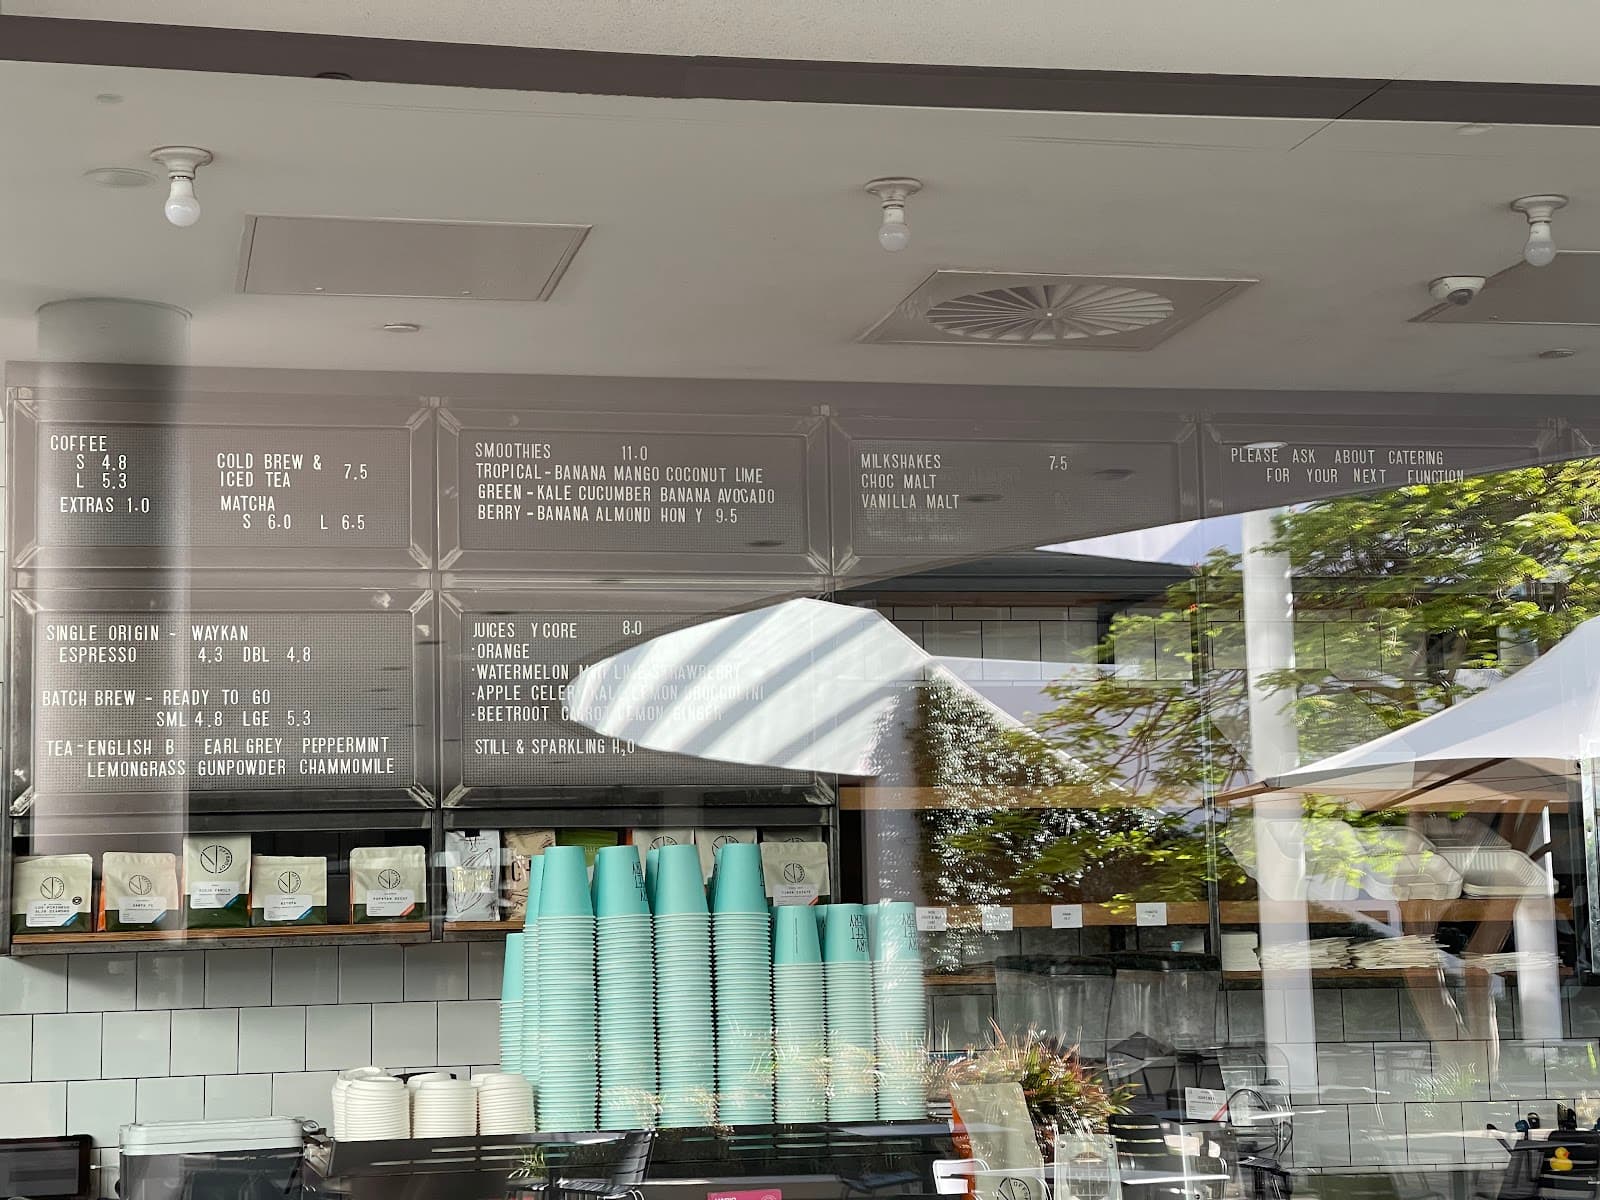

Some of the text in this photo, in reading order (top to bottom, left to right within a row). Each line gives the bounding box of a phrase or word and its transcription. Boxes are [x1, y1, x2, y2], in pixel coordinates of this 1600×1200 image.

[50, 434, 108, 452] COFFEE
[475, 443, 648, 461] SMOOTHIES 11.0
[1231, 448, 1444, 465] PLEASE ASK ABOUT CATERING
[76, 454, 128, 472] S 4.8
[217, 452, 322, 471] COLD BREW &
[861, 453, 1068, 471] MILKSHAKES 7.5
[220, 471, 291, 488] ICED TEA
[344, 463, 368, 480] 7.5
[614, 466, 660, 482] MANGO
[666, 467, 726, 483] COCONUT
[735, 467, 763, 484] LIME
[1266, 467, 1464, 484] FOR YOUR NEXT FUNCTION
[76, 473, 128, 490] L 5.3
[861, 474, 937, 489] CHOC MALT
[220, 495, 275, 511] MATCHA
[579, 486, 651, 502] CUCUMBER
[660, 487, 711, 503] BANANA
[717, 488, 775, 504] AVOCADO
[861, 494, 960, 510] VANILLA MALT
[60, 496, 150, 514] EXTRAS 1.0
[243, 514, 365, 530] S 6.0 L 6.5
[595, 506, 651, 522] ALMOND
[716, 508, 738, 524] 9.5
[46, 625, 98, 641] SINGLE
[108, 625, 160, 641] ORIGIN
[191, 625, 249, 642] WAYKAN
[473, 622, 516, 638] JUICES
[543, 622, 577, 638] CORE
[622, 620, 643, 636] 8.0
[59, 647, 312, 664] ESPRESSO 4.3 DBL 4.8
[477, 643, 530, 659] ORANGE
[476, 664, 569, 680] WATERMELON
[42, 690, 87, 706] BATCH
[94, 690, 136, 706] BREW
[163, 689, 210, 705] READY
[222, 689, 239, 705] TO
[252, 689, 271, 705] GO
[476, 685, 521, 701] APPLE
[531, 685, 583, 701] CELER
[156, 710, 312, 728] SML 4.8 LGE 5.3
[477, 705, 549, 722] BEETROOT
[166, 738, 175, 754] B
[204, 738, 240, 754] EARL
[246, 737, 283, 754] GREY
[302, 737, 390, 753] PEPPERMINT
[475, 739, 509, 755] STILL
[516, 739, 525, 754] &
[532, 738, 605, 754] SPARKLING
[87, 758, 395, 778] LEMONGRASS GUNPOWDER CHAMMOMILE
